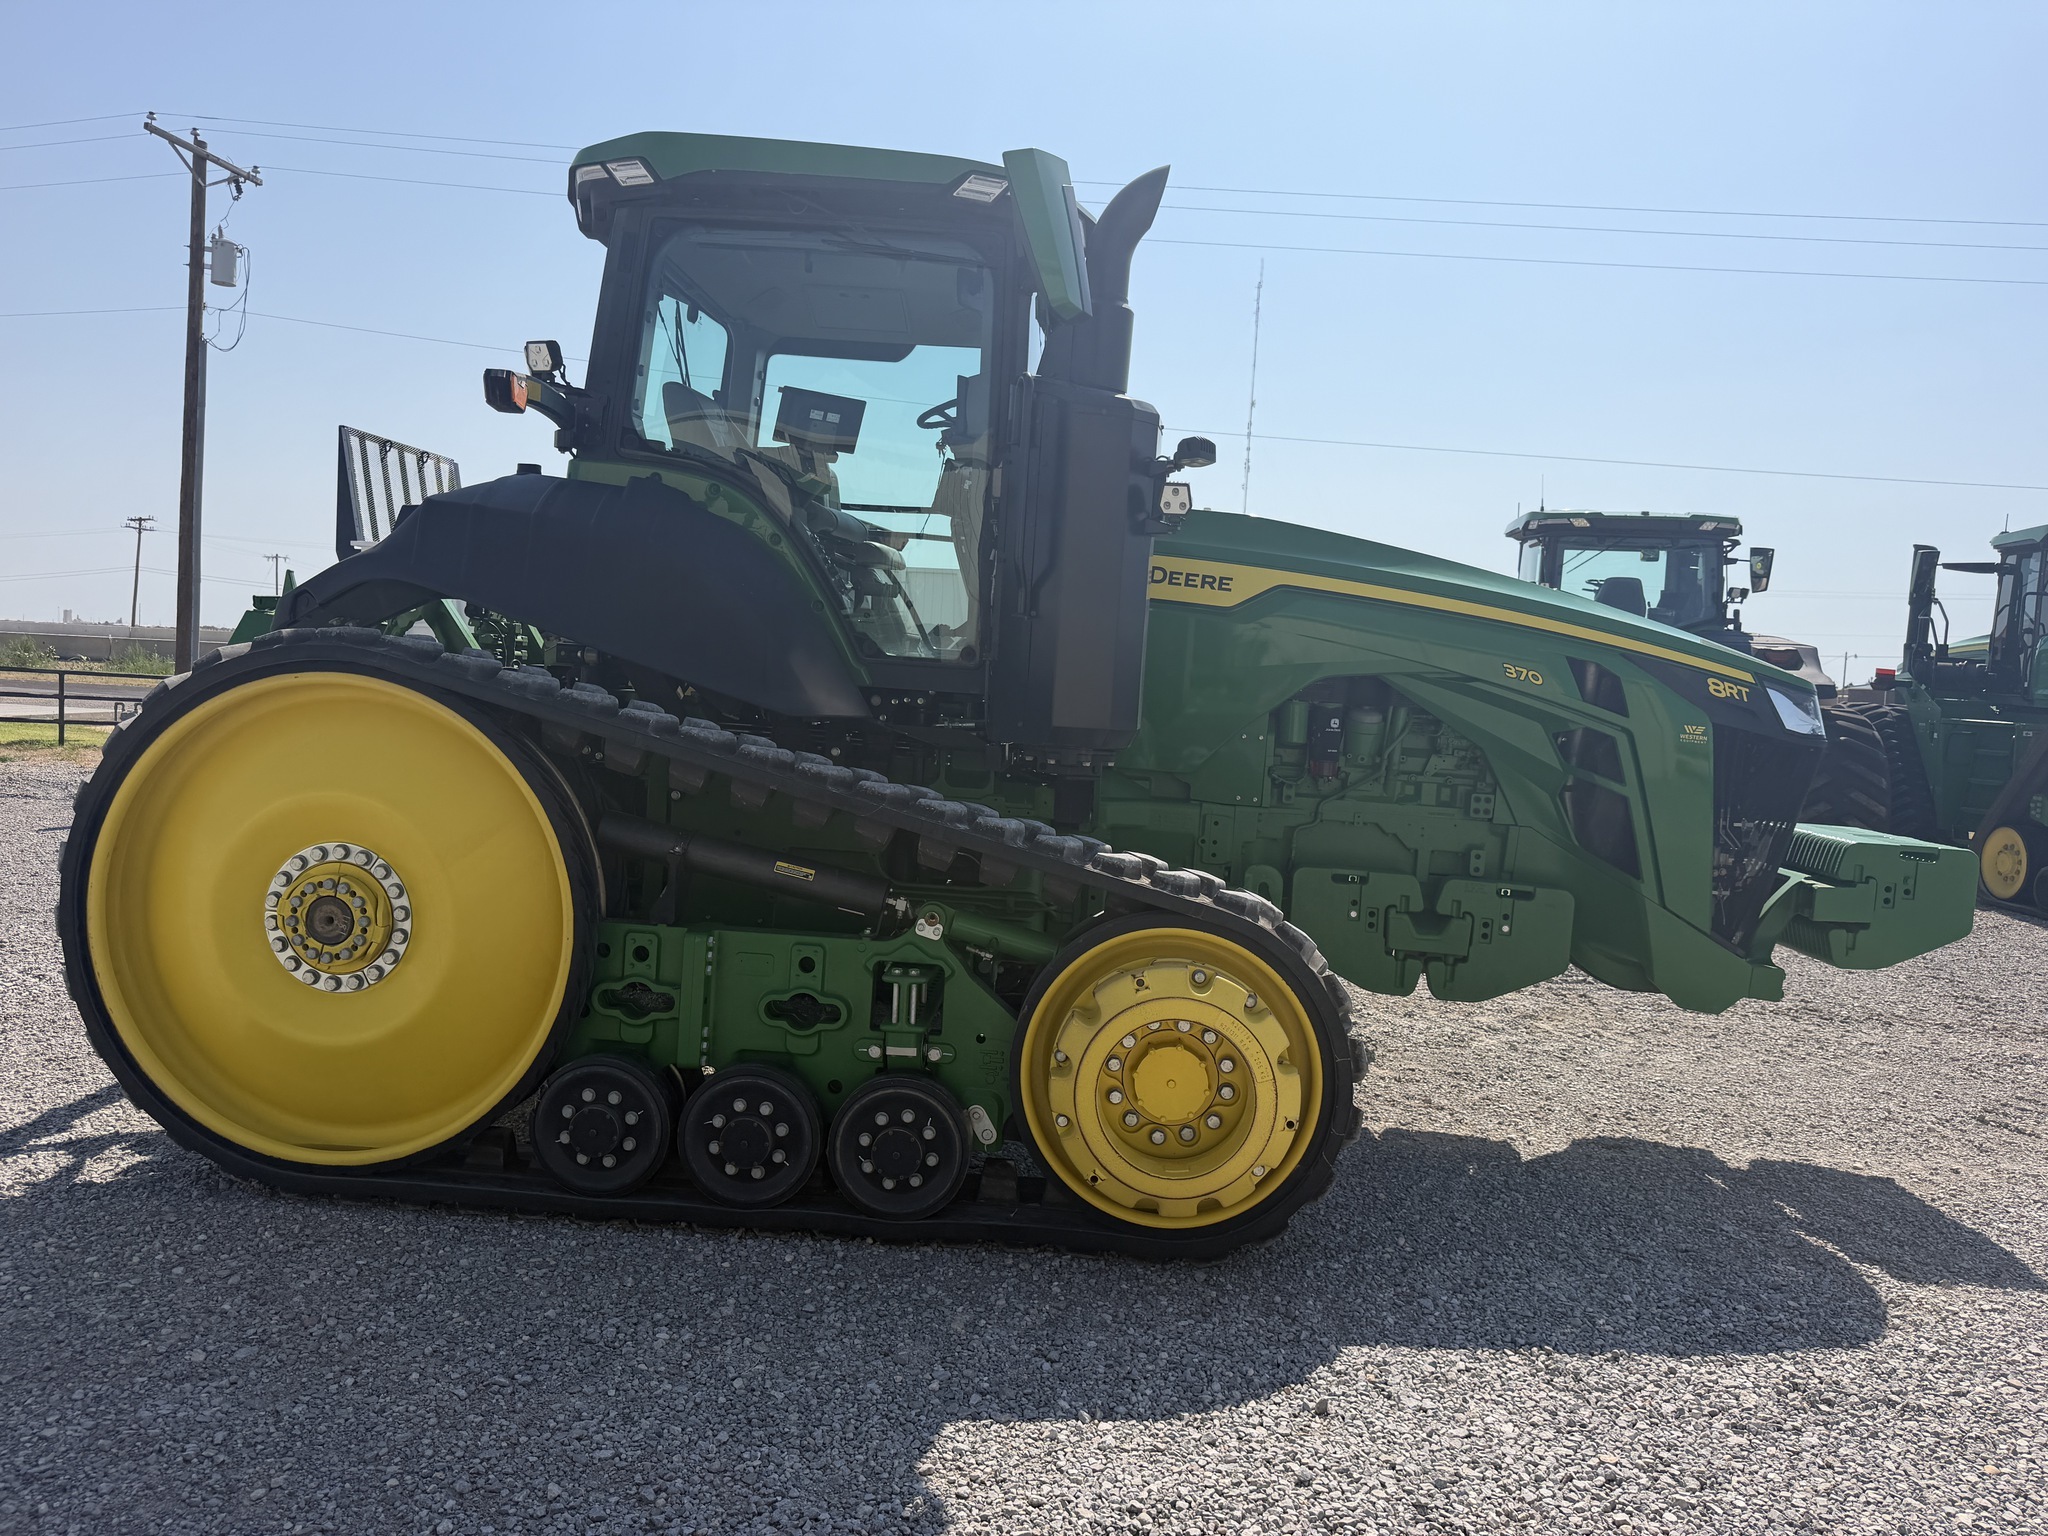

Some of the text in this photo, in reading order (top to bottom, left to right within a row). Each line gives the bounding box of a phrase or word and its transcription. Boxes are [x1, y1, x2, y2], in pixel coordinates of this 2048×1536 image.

[1150, 566, 1234, 592] DEERE
[1503, 663, 1543, 685] 370
[1707, 677, 1750, 702] 8RT
[1679, 733, 1708, 741] WESTERN
